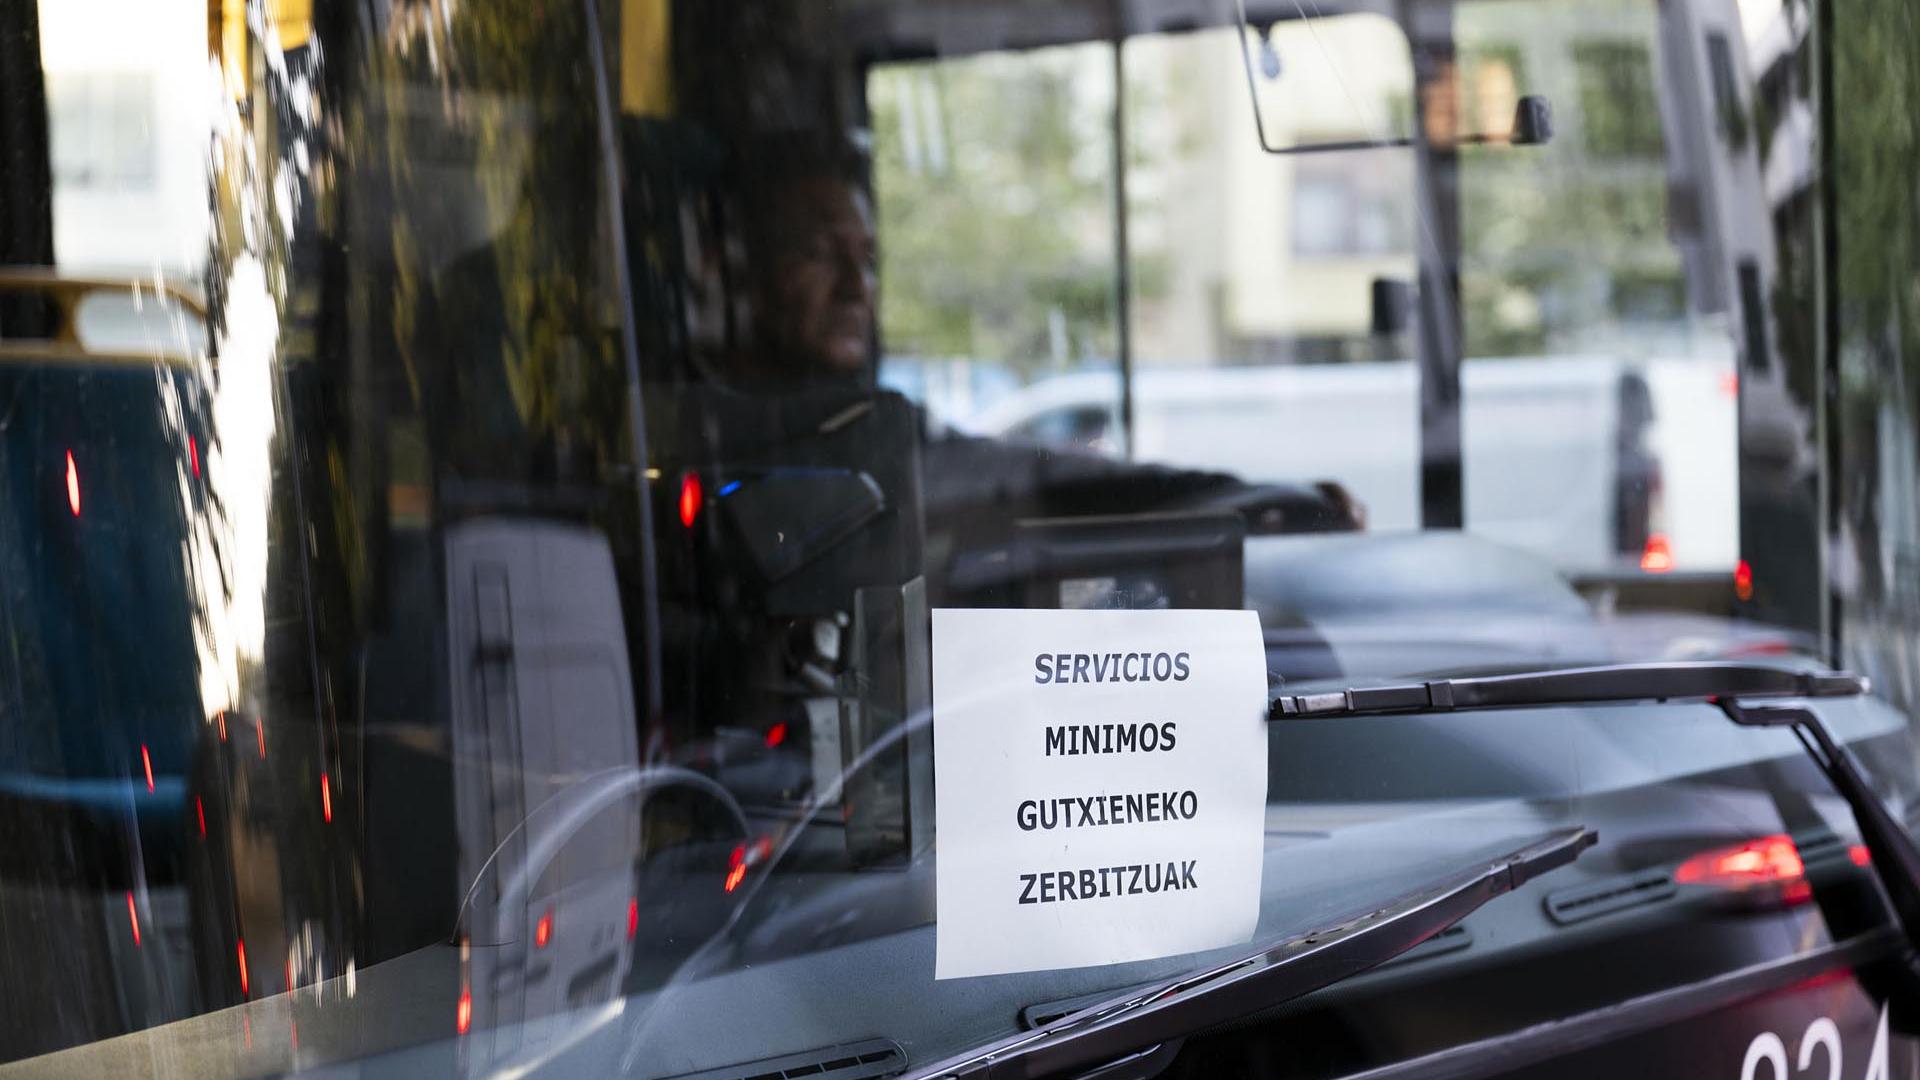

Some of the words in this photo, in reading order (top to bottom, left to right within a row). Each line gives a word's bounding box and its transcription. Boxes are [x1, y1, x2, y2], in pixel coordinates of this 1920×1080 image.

[1035, 652, 1190, 684] SERVICIOS
[1045, 722, 1177, 756] MINIMOS
[1017, 790, 1198, 831] GUTXIENEKO
[1018, 860, 1198, 904] ZERBITZUAK
